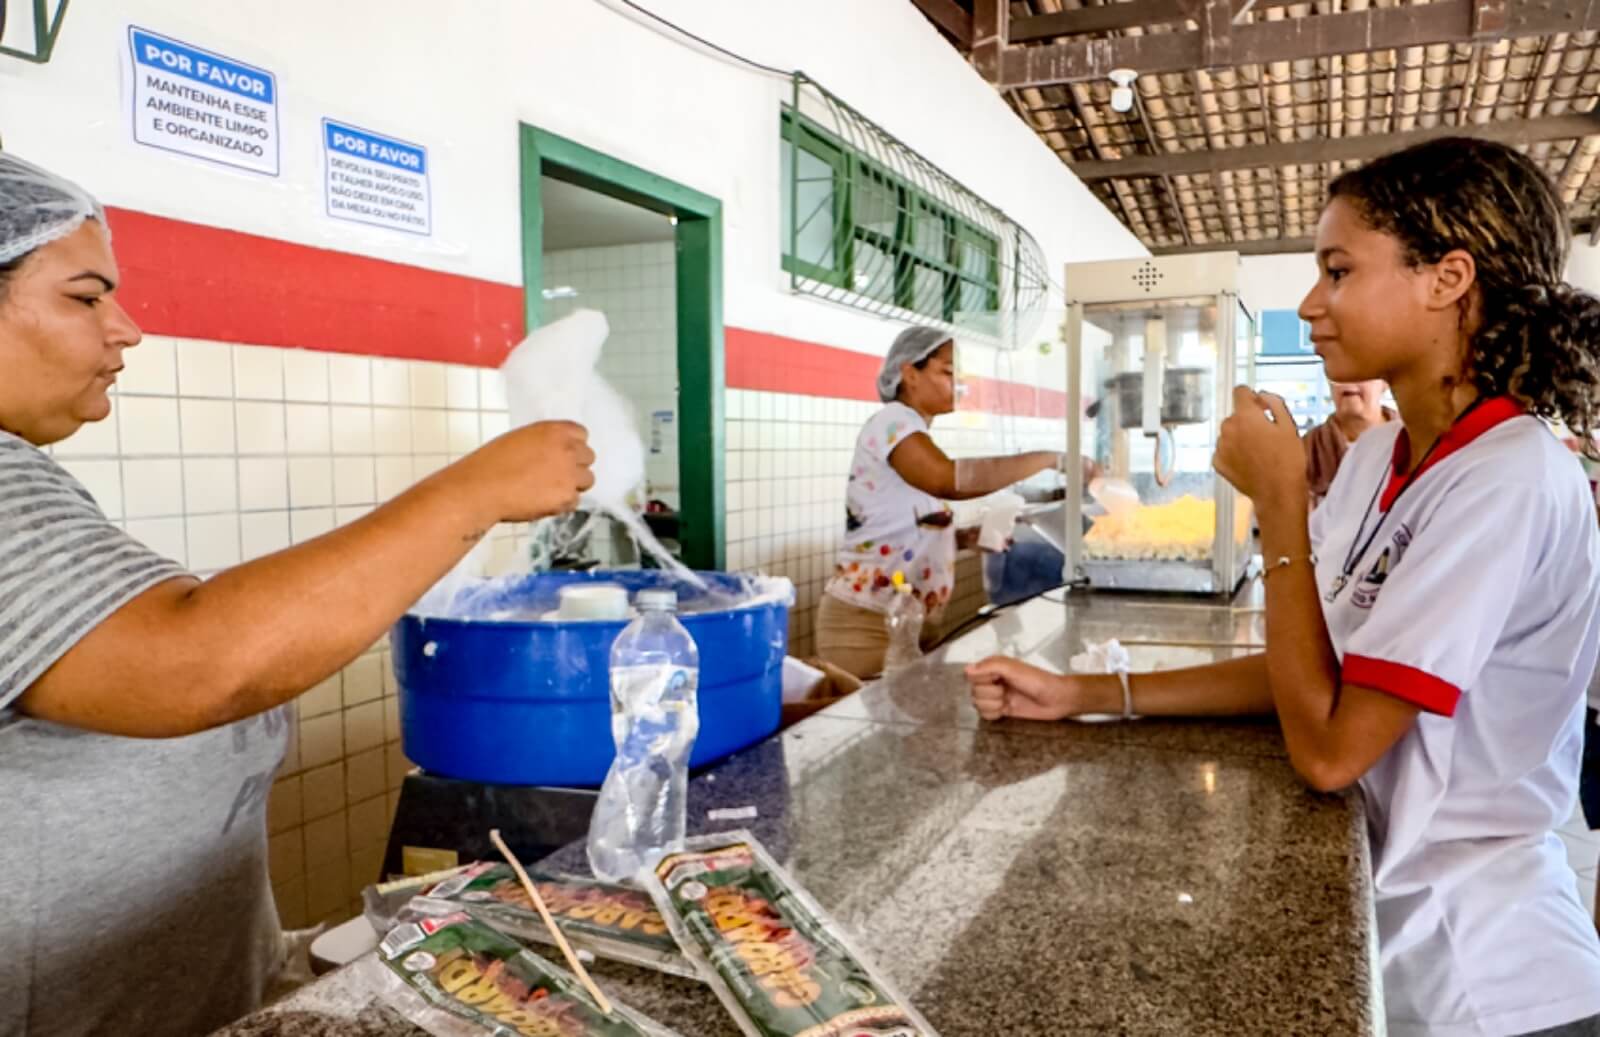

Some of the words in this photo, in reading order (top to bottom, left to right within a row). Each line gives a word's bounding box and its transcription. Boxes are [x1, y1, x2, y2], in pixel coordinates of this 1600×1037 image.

[145, 43, 192, 73] POR
[197, 61, 265, 96] FAVOR
[146, 96, 223, 128] AMBIENTE
[226, 119, 269, 140] LIMPO
[147, 75, 231, 112] MANTENHA
[234, 102, 267, 123] ESSE
[153, 118, 163, 131] E
[166, 122, 263, 157] ORGANIZADO
[333, 132, 368, 154] POR
[370, 143, 420, 169] FAVOR
[331, 184, 351, 197] NÃO
